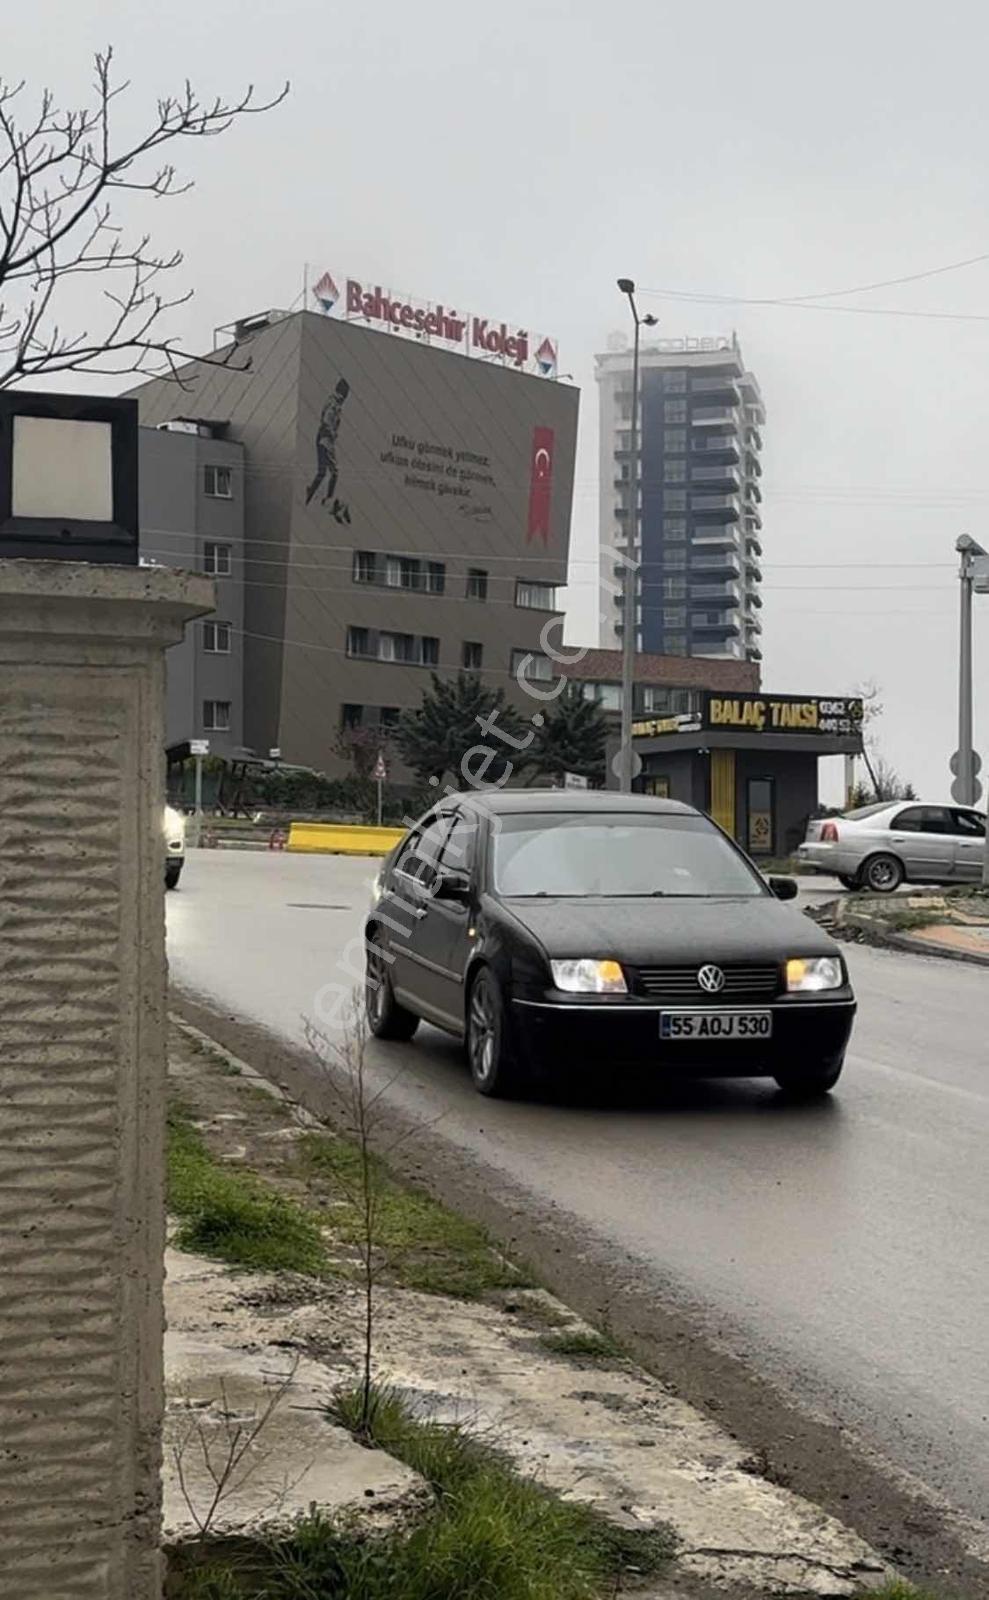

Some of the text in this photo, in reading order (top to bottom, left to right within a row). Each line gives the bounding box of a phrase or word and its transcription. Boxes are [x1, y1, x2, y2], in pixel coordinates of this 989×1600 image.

[347, 279, 529, 366] Bahçeşehir Koleji
[709, 698, 766, 731] BALAÇ
[769, 699, 818, 728] TAKSİ
[671, 1016, 770, 1036] 55 AOJ 530
